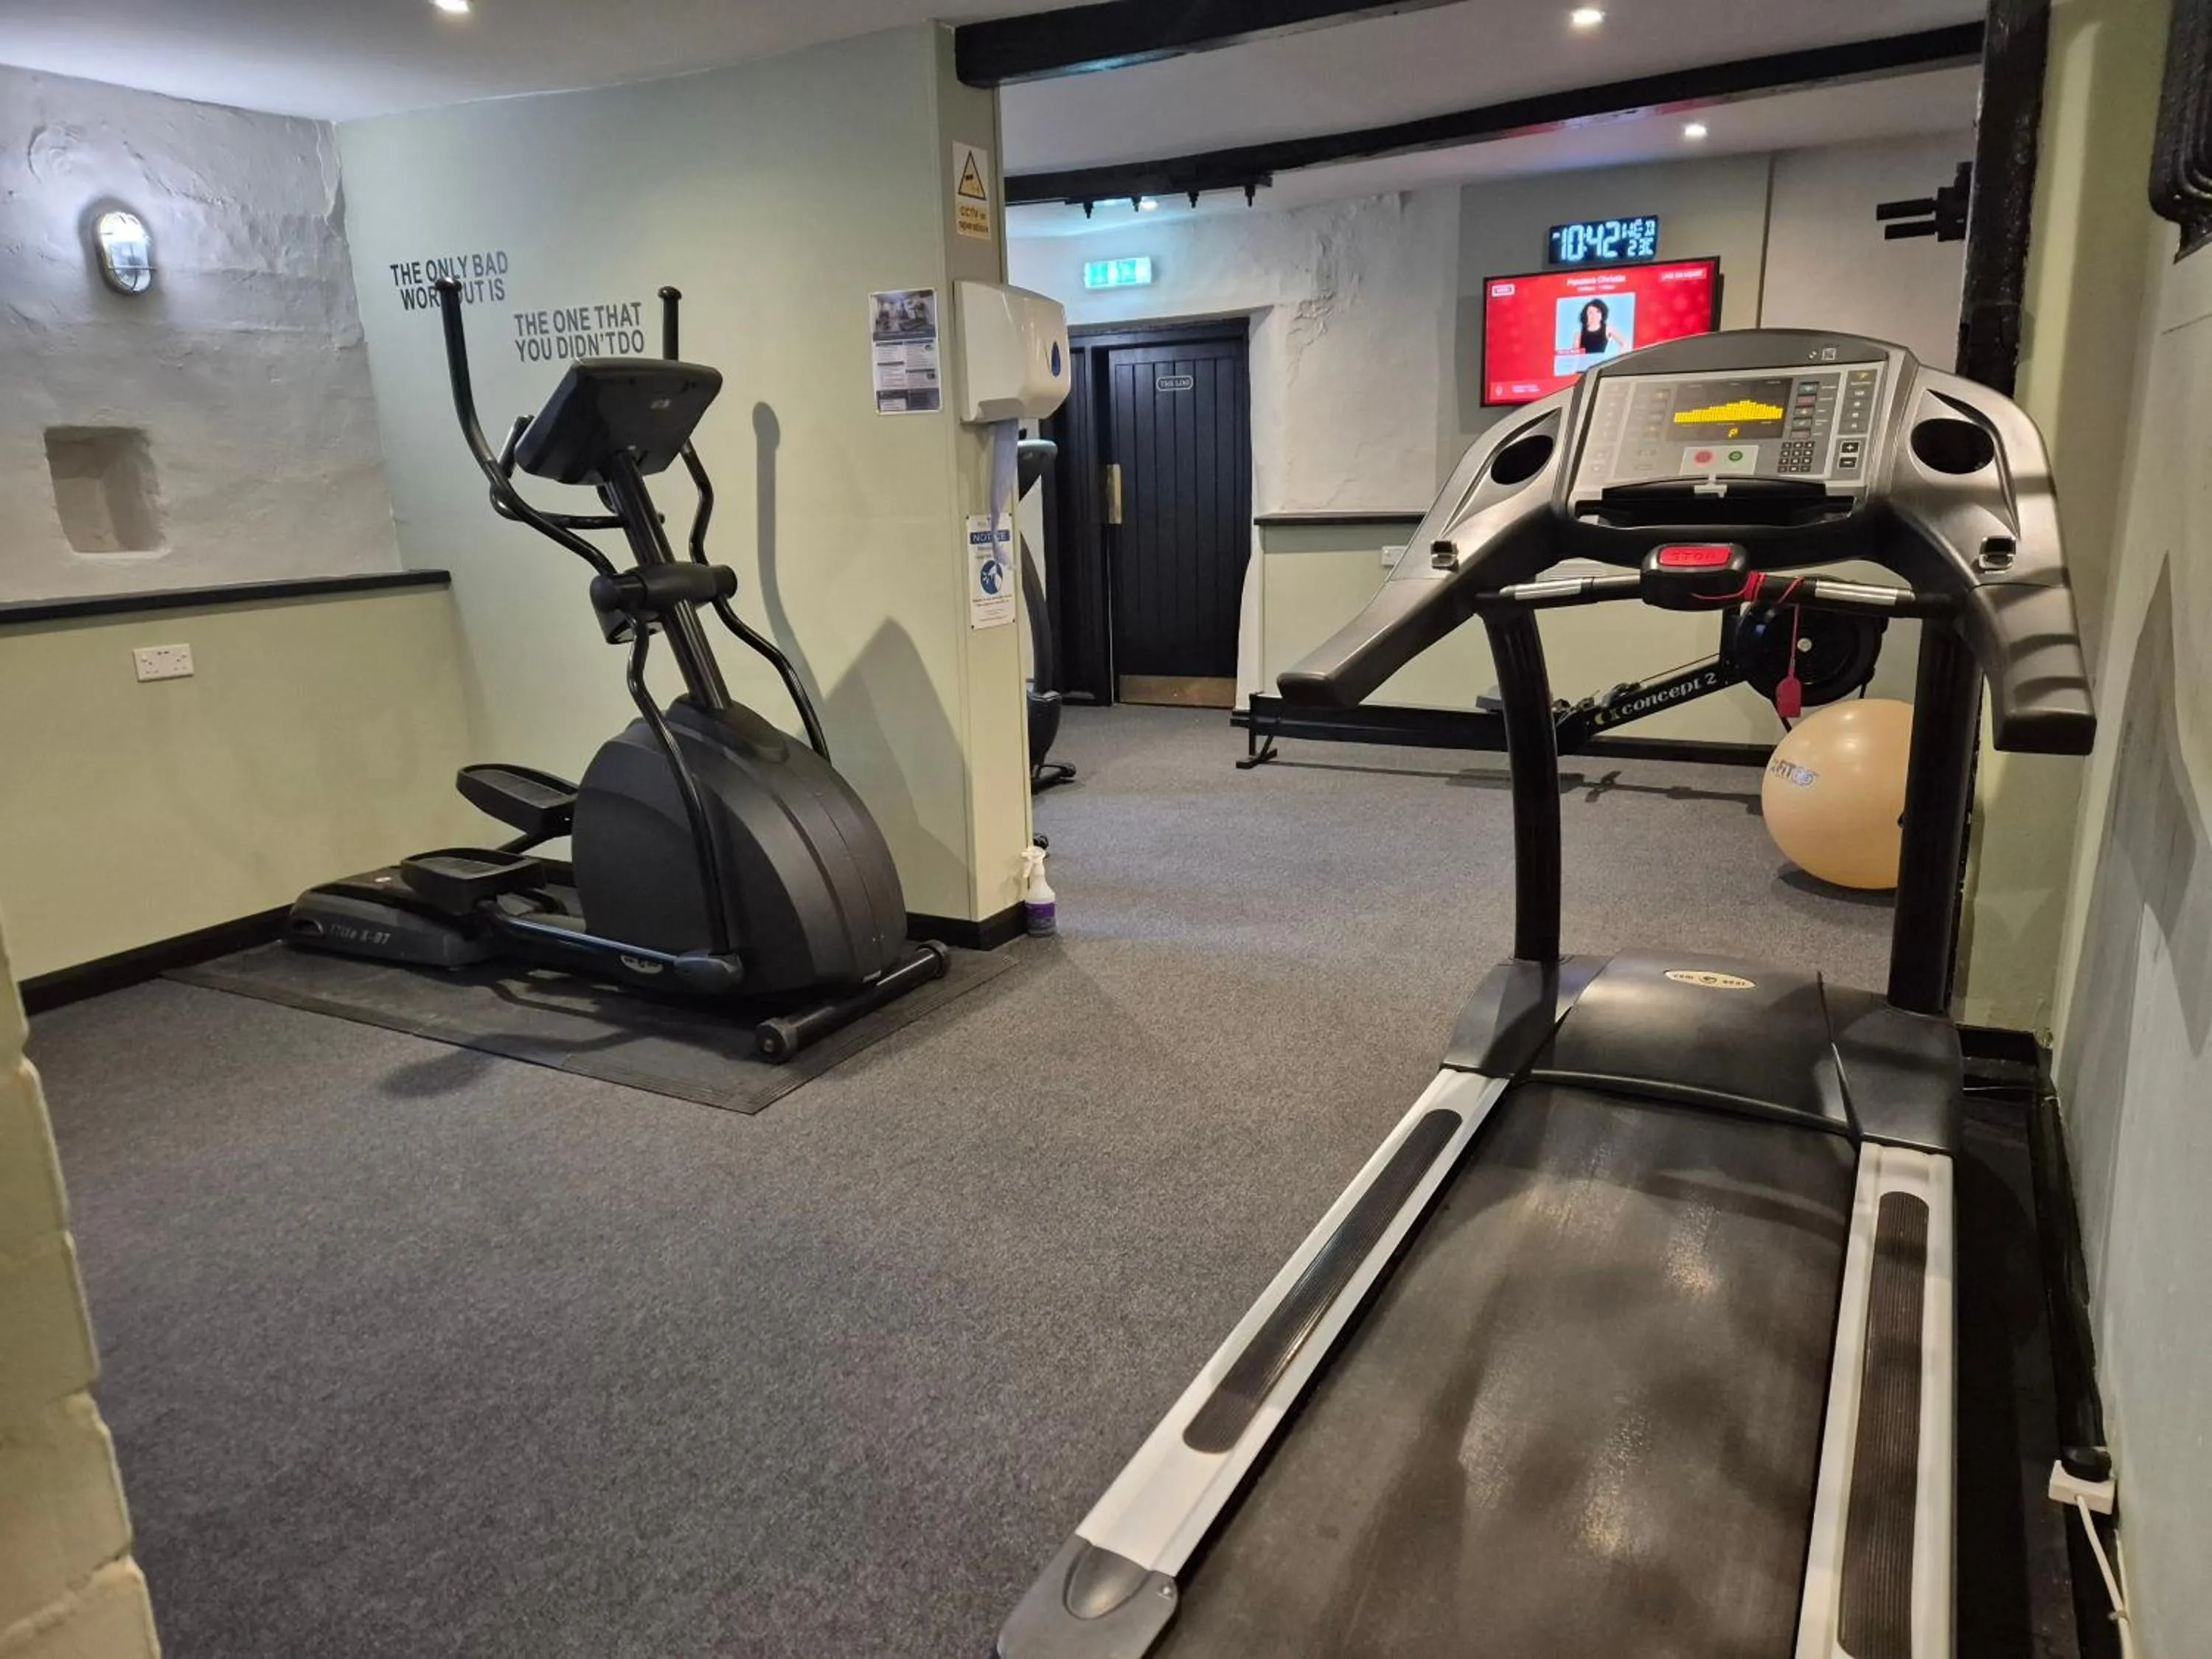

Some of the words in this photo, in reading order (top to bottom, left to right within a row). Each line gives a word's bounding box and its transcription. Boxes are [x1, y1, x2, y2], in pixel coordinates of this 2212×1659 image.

[389, 262, 422, 286] THE
[425, 255, 467, 282] ONLY
[472, 251, 509, 277] BAD
[400, 280, 484, 310] WORUT
[488, 278, 505, 302] IS
[514, 311, 549, 336] THE
[554, 307, 591, 333] ONE
[594, 302, 641, 329] THAT
[515, 337, 552, 362] YOU
[557, 331, 616, 359] DIDN'T
[619, 329, 644, 355] DO
[1622, 678, 1703, 714] concept
[1705, 672, 1717, 685] 2
